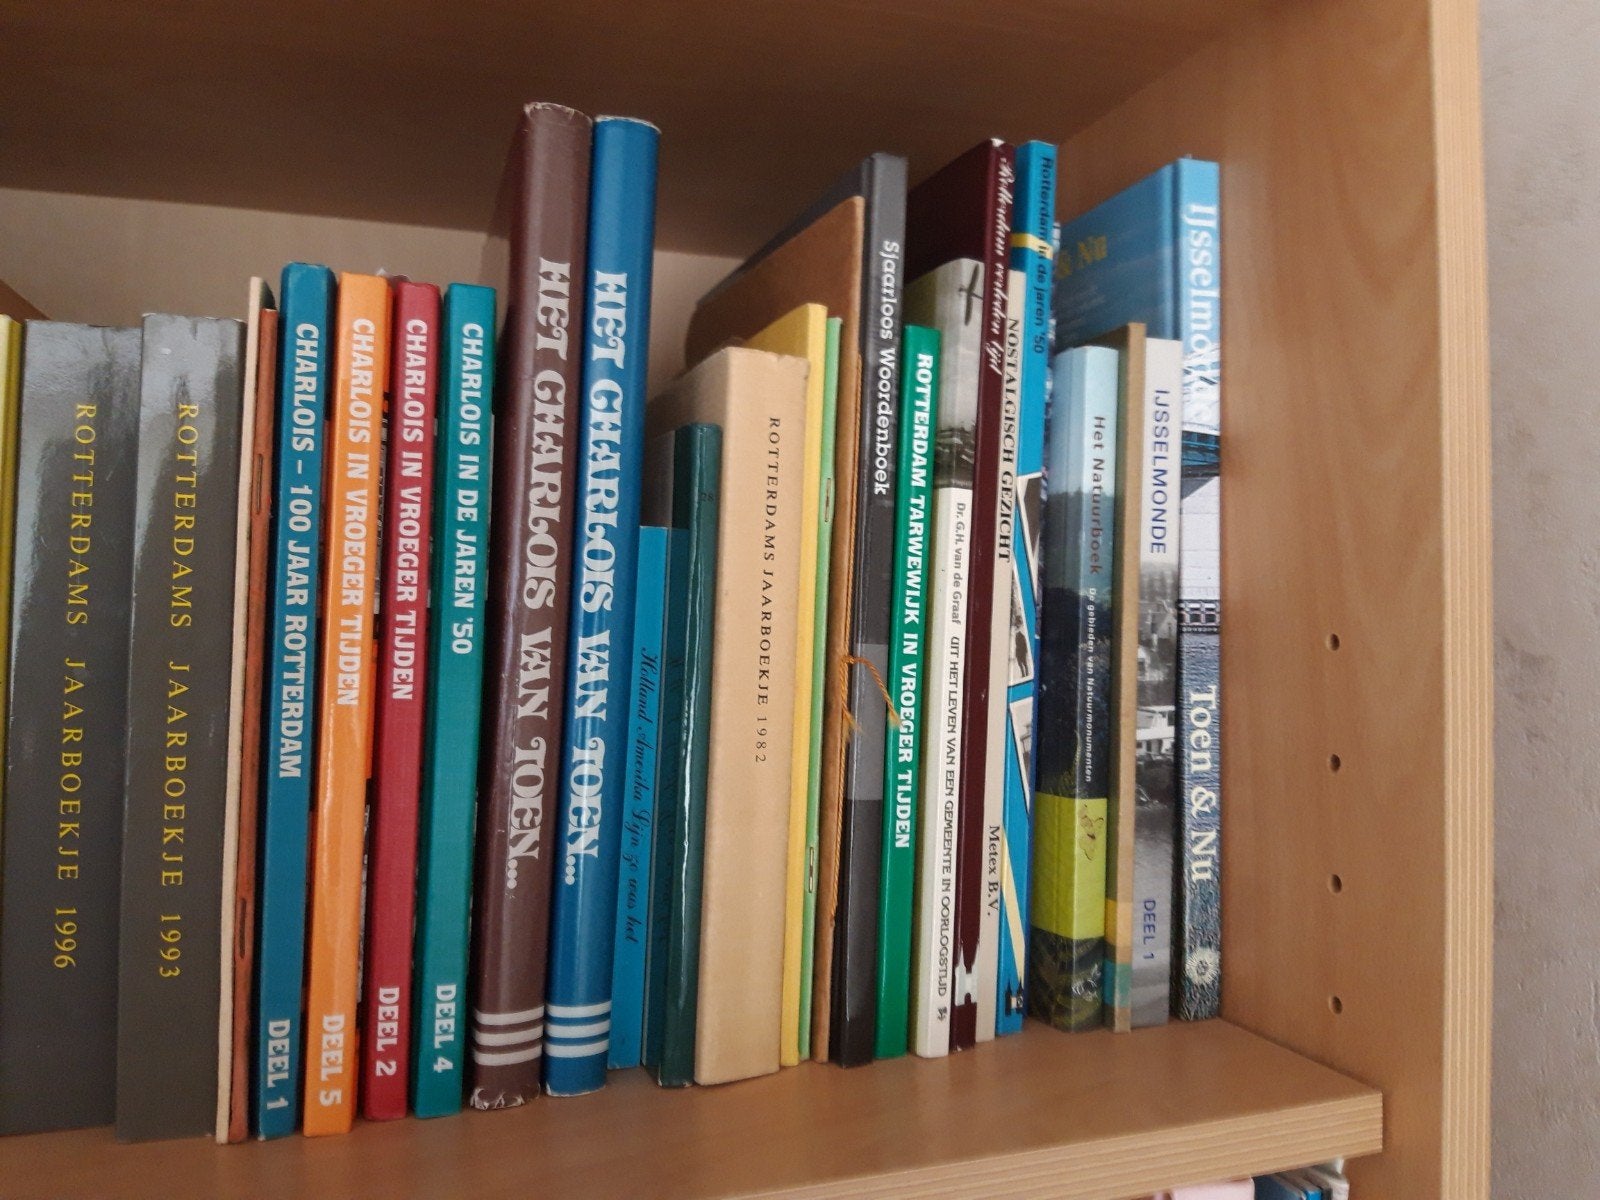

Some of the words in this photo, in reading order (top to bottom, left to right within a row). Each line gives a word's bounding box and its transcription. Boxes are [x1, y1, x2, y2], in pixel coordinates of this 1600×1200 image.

[1038, 157, 1054, 239] Rotterdam
[1036, 264, 1048, 284] de
[1038, 243, 1050, 259] in
[536, 256, 571, 361] HET
[592, 270, 628, 369] HET
[879, 240, 899, 340] Sjaarloos
[1034, 287, 1048, 326] jaren
[292, 323, 319, 452] CHARLOIS
[347, 319, 374, 444] CHARLOIS
[402, 319, 428, 443] CHARLOIS
[458, 323, 484, 446] CHARLOIS
[1001, 318, 1019, 464] NOSTALGISCH
[873, 348, 896, 495] Woordenboek
[910, 353, 934, 487] ROTTERDAM
[1093, 416, 1106, 450] Het
[347, 453, 369, 479] IN
[401, 451, 422, 478] IN
[457, 454, 479, 481] IN
[523, 370, 567, 610] CHARLOIS
[580, 378, 623, 613] CHARLOIS
[764, 417, 781, 562] ROTTERDAMS
[1150, 390, 1171, 555] IJSSELMONDE
[66, 403, 97, 625] ROTTERDAMS
[170, 403, 199, 628] ROTTERDAMS
[288, 484, 312, 532] 100
[456, 490, 478, 522] DE
[955, 521, 965, 545] G.H.
[956, 502, 966, 519] Dr.
[999, 470, 1014, 563] GEZICHT
[1091, 458, 1106, 575] Natuurboek
[286, 540, 311, 606] JAAR
[340, 486, 369, 607] VROEGER
[396, 486, 422, 604] VROEGER
[452, 529, 477, 608] JAREN
[903, 495, 925, 625] TARWEWIJK
[953, 548, 963, 569] van
[951, 590, 963, 625] Graaf
[953, 572, 963, 588] de
[1089, 588, 1097, 600] De
[337, 615, 363, 706] TIJDEN
[392, 611, 417, 700] TIJDEN
[758, 568, 775, 708] JAARBOEKJE
[903, 632, 918, 655] IN
[950, 636, 960, 658] UIT
[1087, 604, 1097, 653] gebieden
[279, 615, 307, 778] ROTTERDAM
[516, 626, 552, 720] VAN
[574, 630, 610, 722] VAN
[638, 647, 658, 724] Holland
[949, 661, 959, 686] HET
[1086, 656, 1095, 675] van
[755, 716, 769, 763] 1982
[898, 662, 918, 763] VROEGER
[947, 690, 958, 734] LEVEN
[1085, 678, 1095, 782] Natuurmonumenten
[1188, 684, 1217, 774] Toen
[57, 658, 86, 880] JAARBOEKJE
[161, 661, 190, 887] JAARBOEKJE
[633, 726, 654, 800] Amerika
[945, 770, 955, 797] EEN
[946, 738, 956, 765] VAN
[624, 809, 651, 847] Lijn
[895, 770, 912, 848] TIJDEN
[1190, 786, 1216, 819] &
[622, 854, 639, 872] zo
[942, 800, 954, 874] GEMEENTE
[988, 825, 1002, 875] Metex
[1191, 829, 1217, 881] Nu
[627, 878, 638, 909] was
[941, 878, 951, 893] IN
[987, 880, 1001, 916] B.V.
[53, 907, 78, 969] 1996
[159, 913, 182, 978] 1993
[624, 916, 642, 943] het
[938, 896, 951, 997] OORLOGSTIJD
[1143, 899, 1157, 947] DEEL
[1142, 952, 1155, 960] 1
[320, 1013, 345, 1081] DEEL
[375, 987, 400, 1052] DEEL
[434, 984, 457, 1049] DEEL
[267, 1018, 291, 1088] DEEL
[375, 1060, 397, 1077] 2
[432, 1055, 454, 1074] 4
[266, 1097, 289, 1110] 1
[319, 1089, 342, 1107] 5
